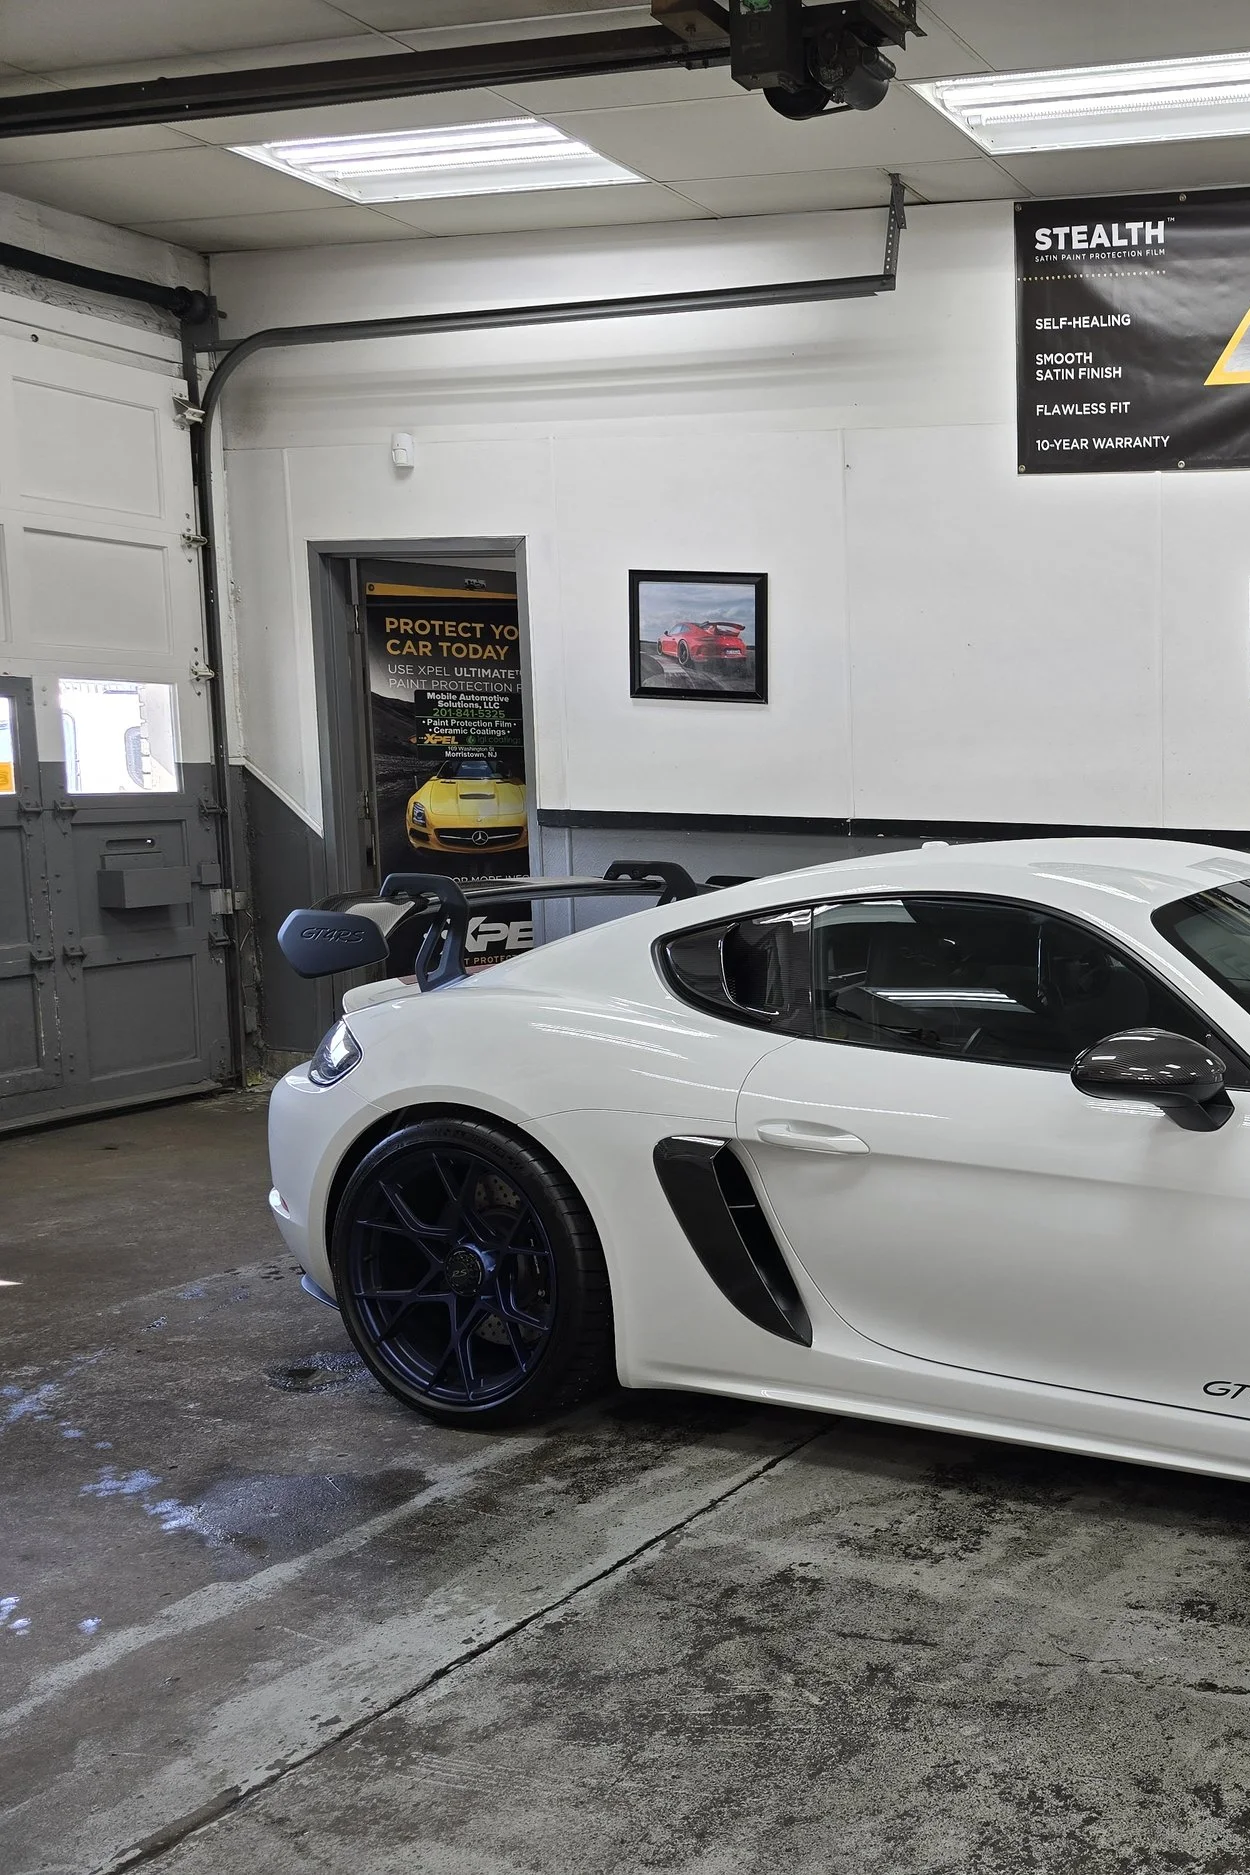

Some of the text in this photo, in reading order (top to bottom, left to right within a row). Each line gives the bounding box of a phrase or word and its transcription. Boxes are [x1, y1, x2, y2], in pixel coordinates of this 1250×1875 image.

[1034, 221, 1165, 251] STEALTH
[1035, 248, 1166, 262] SATIN PAINT PROTECTION FILM
[1035, 314, 1131, 330] SELF-HEALING
[1036, 352, 1093, 365] SMOOTH
[1036, 366, 1122, 381] SATIN FINISH
[1036, 401, 1131, 416] FLAWLESS FIT
[1036, 435, 1170, 451] 10-YEAR WARRANTY
[385, 617, 519, 641] PROTECT YO
[386, 639, 509, 660] CAR TODAY
[388, 664, 414, 675] USE
[417, 665, 450, 677] XPEL
[389, 678, 427, 690] PAINT
[431, 680, 513, 693] PROTECTION
[427, 692, 510, 702] Mobile Automotive
[437, 700, 482, 709] Solutions,
[432, 708, 506, 719] 201-841-5325
[427, 719, 512, 728] Paint Protection Film
[433, 727, 506, 737] Ceramic Coatings
[424, 733, 459, 745] XPEL
[445, 751, 486, 759] Morristown,
